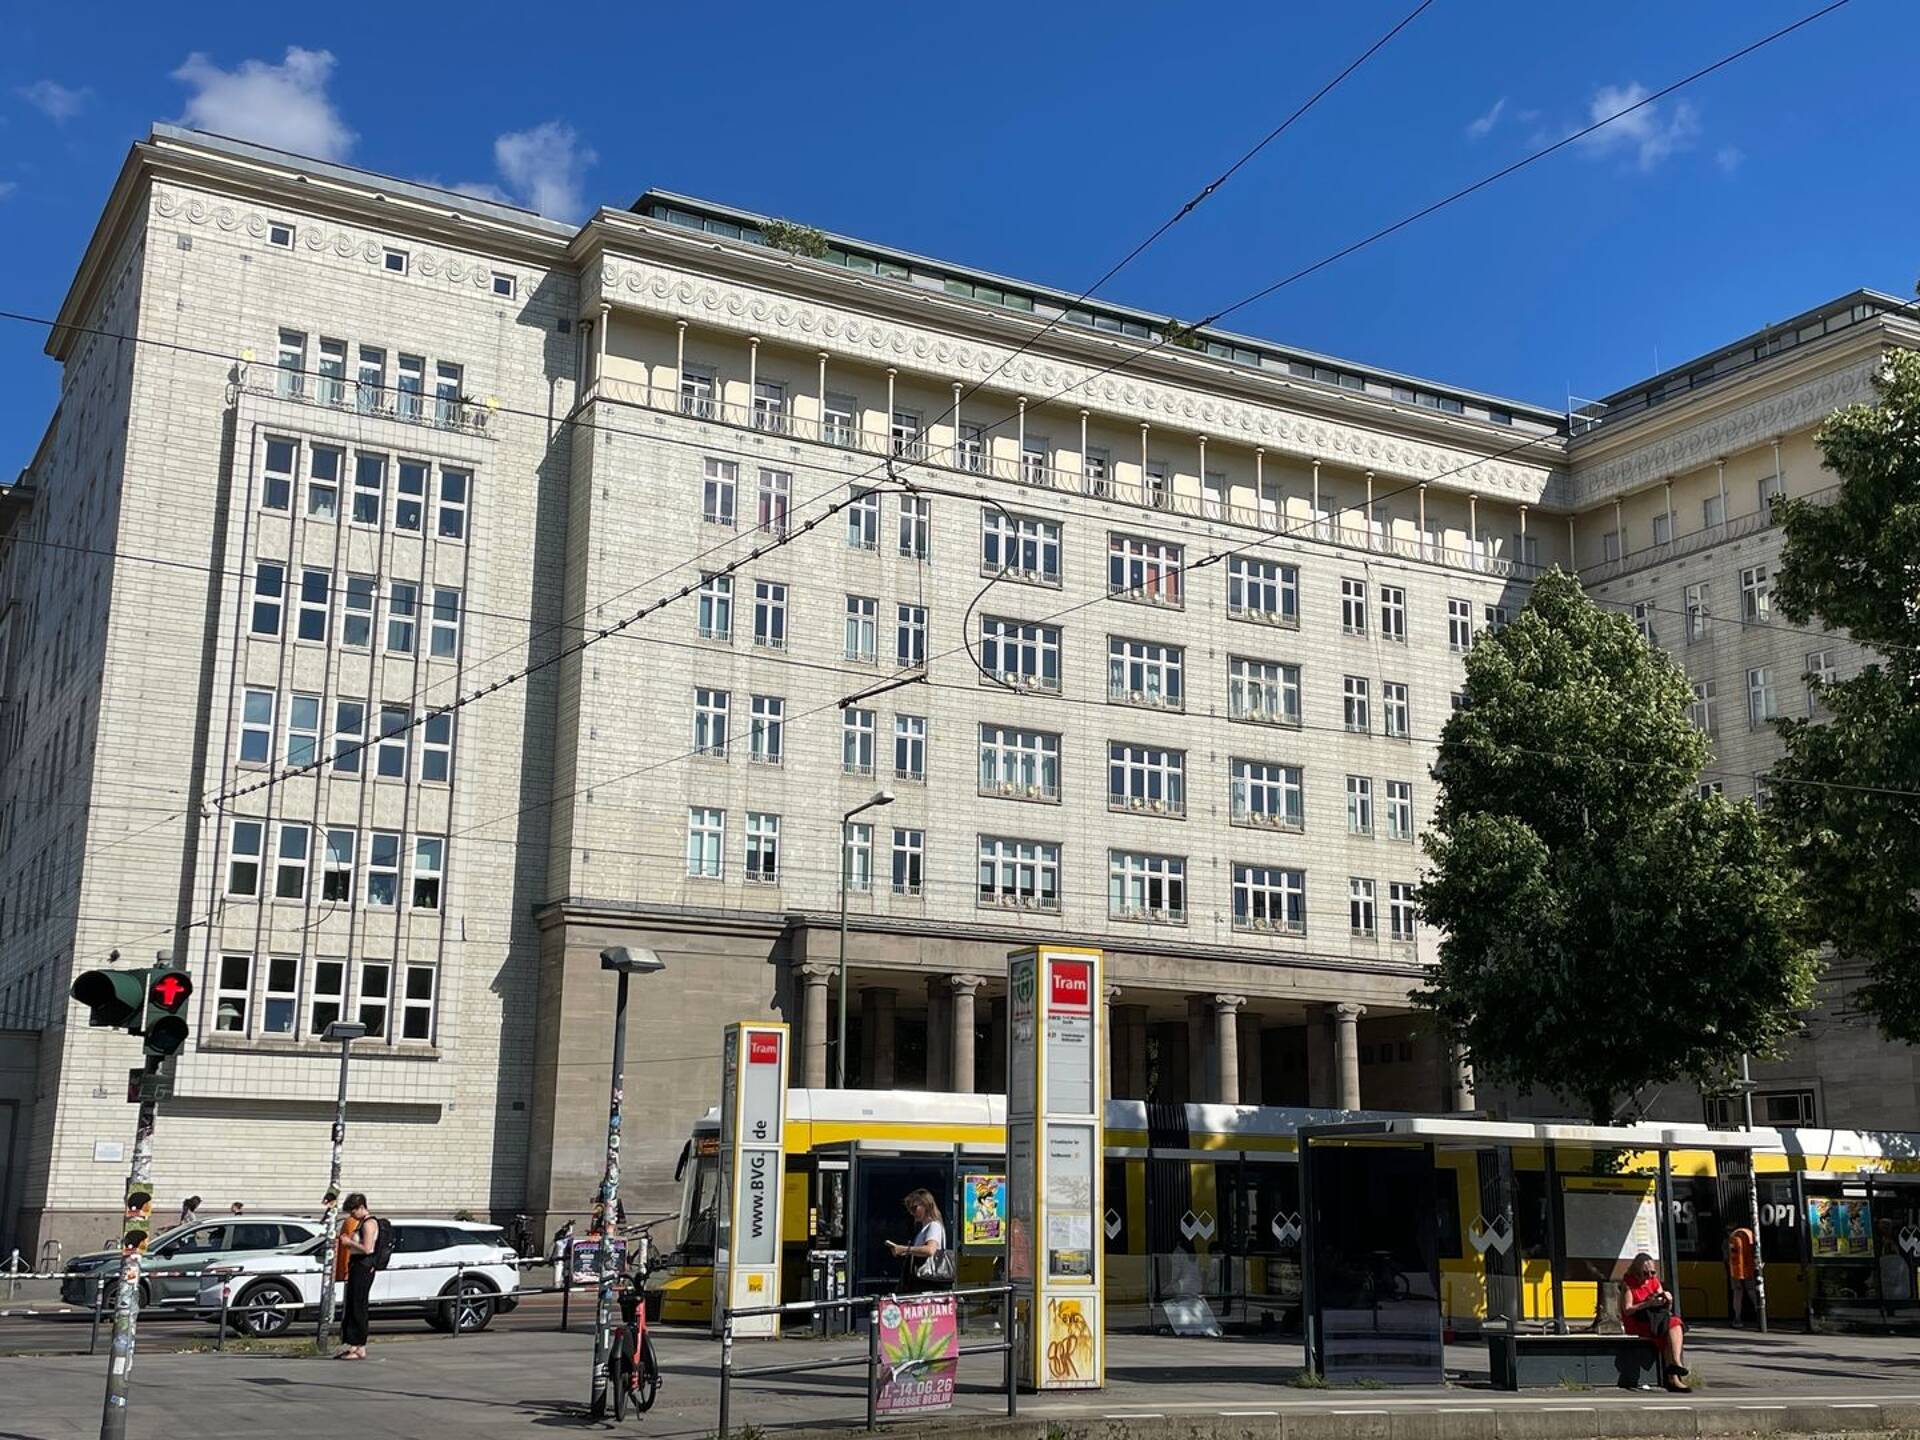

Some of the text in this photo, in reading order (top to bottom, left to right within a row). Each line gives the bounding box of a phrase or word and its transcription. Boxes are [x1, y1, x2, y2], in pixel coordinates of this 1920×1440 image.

[1053, 974, 1086, 990] Tram
[751, 1041, 777, 1054] Tram
[903, 1302, 954, 1319] MARY JANE
[892, 1391, 952, 1408] MESSE BERLIN
